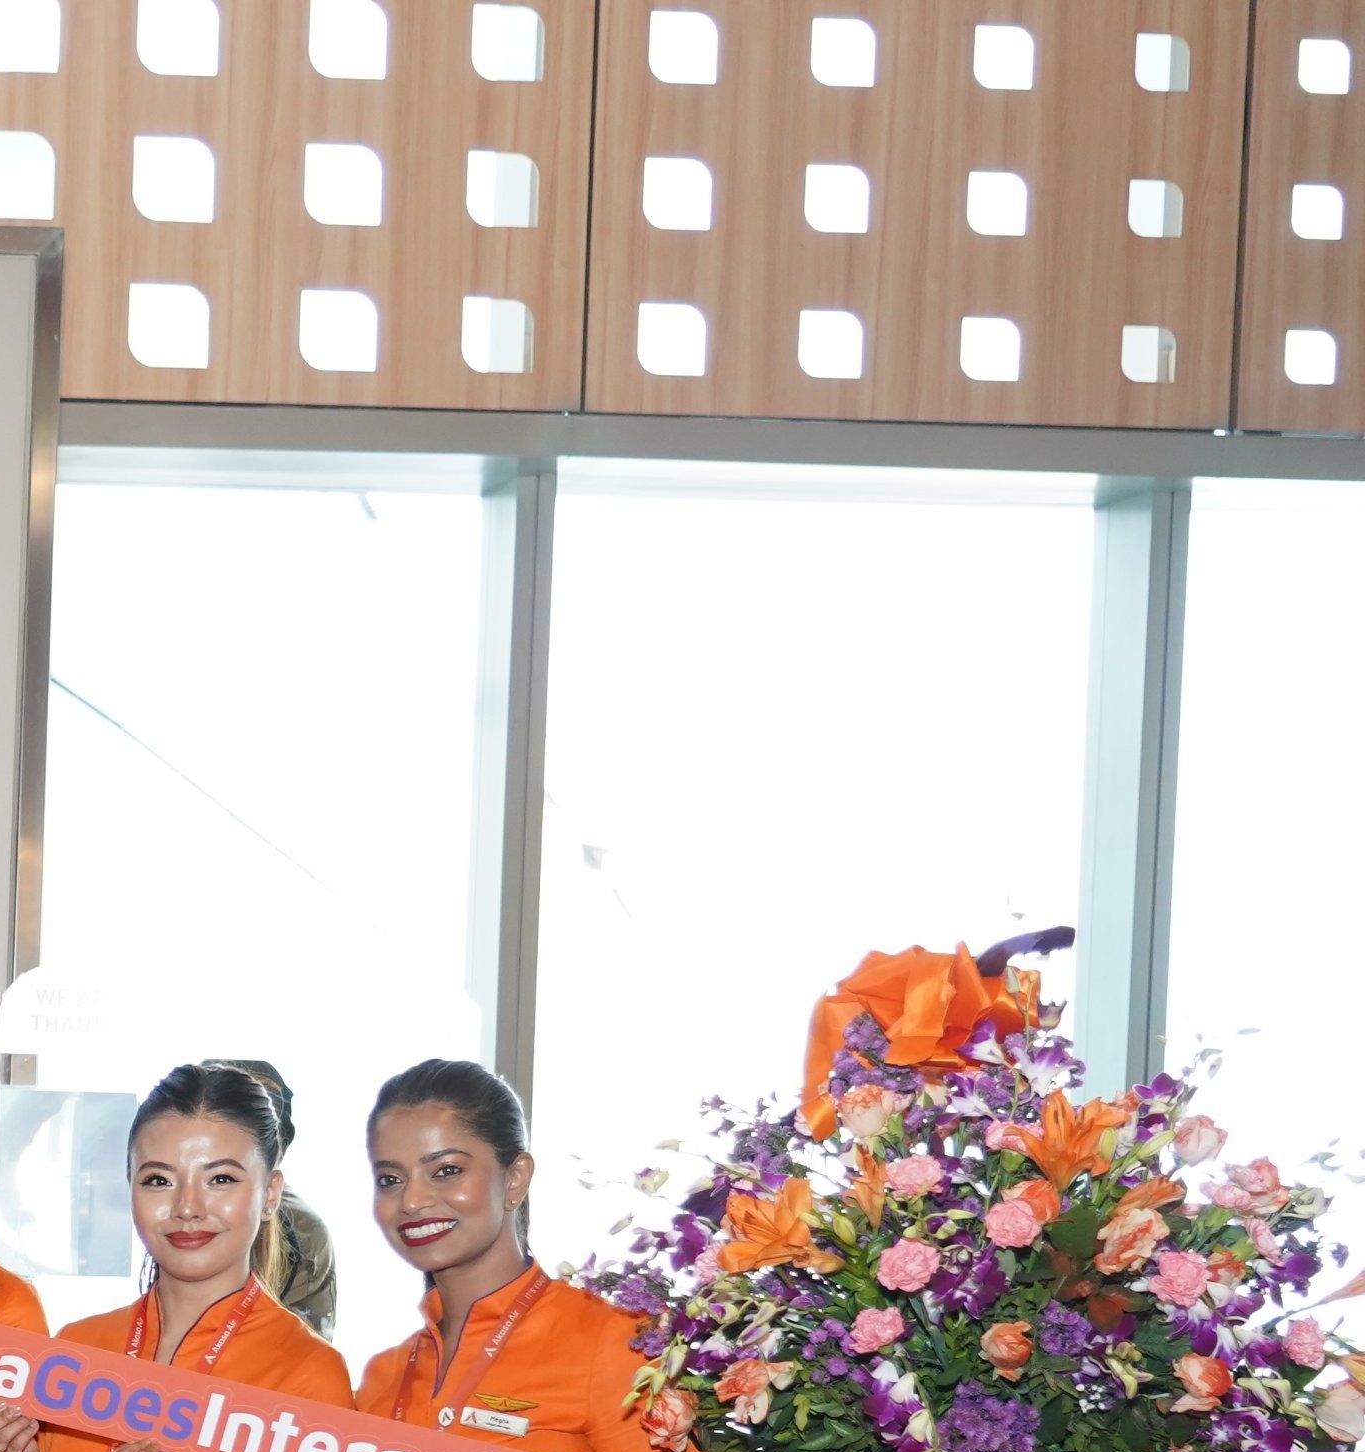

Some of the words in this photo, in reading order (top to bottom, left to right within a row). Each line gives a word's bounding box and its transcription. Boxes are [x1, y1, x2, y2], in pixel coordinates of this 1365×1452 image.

[131, 1326, 142, 1348] Akasa
[211, 1330, 230, 1354] Akasa
[225, 1319, 238, 1332] Air
[492, 1321, 512, 1346] Akasa
[508, 1309, 520, 1322] Air
